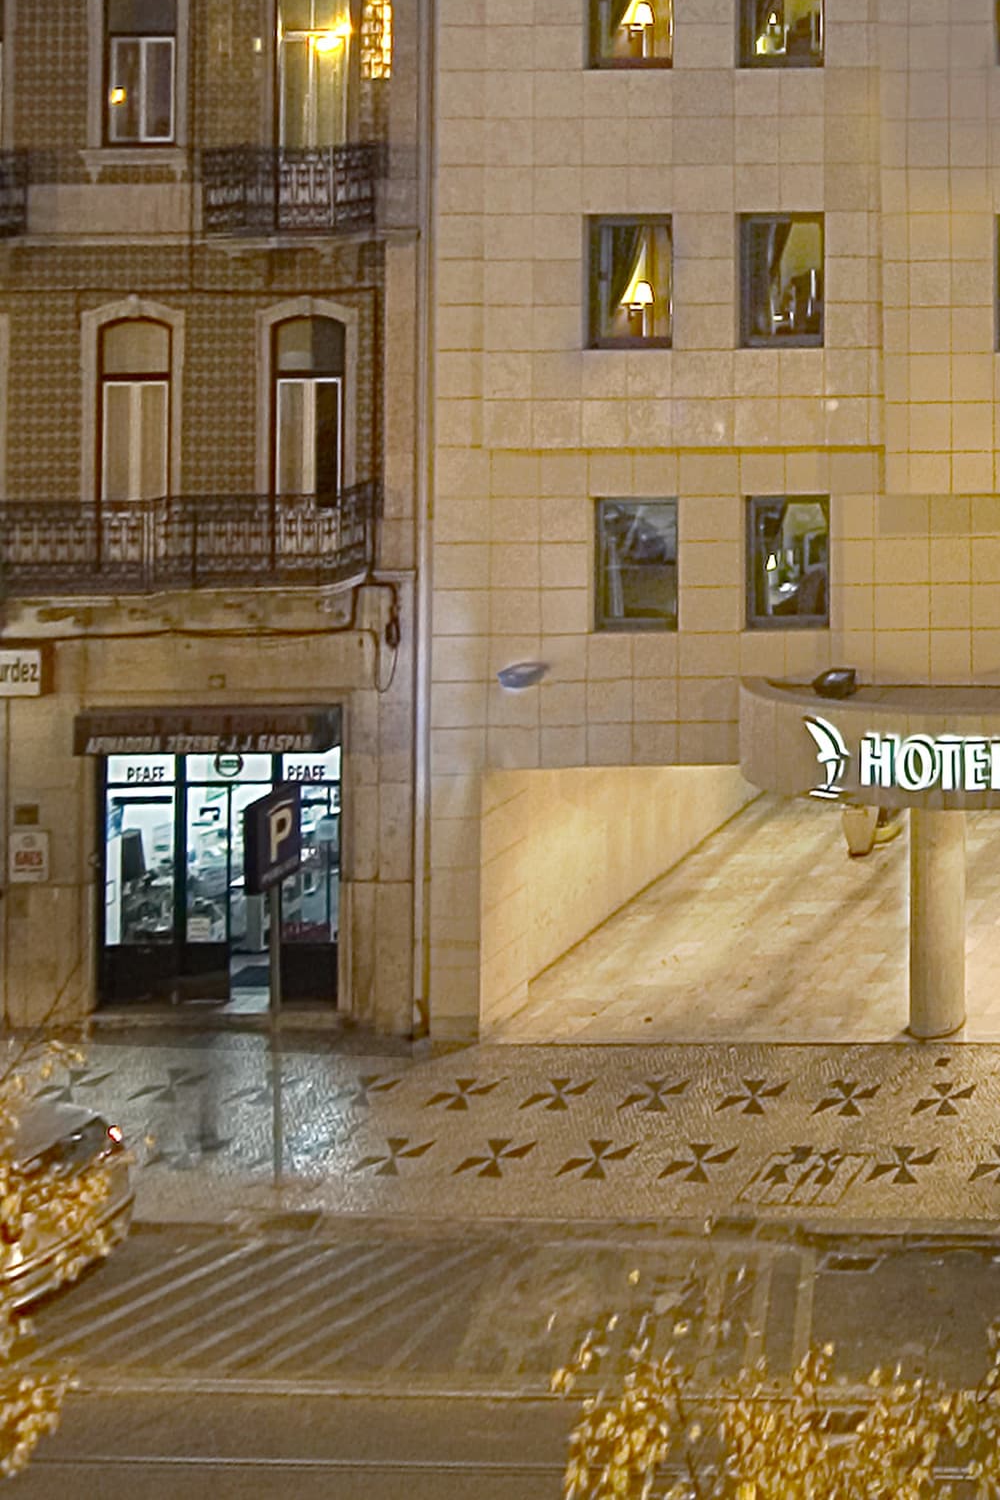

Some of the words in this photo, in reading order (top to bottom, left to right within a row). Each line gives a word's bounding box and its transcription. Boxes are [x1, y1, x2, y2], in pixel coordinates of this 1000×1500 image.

[127, 766, 165, 781] PFAFF
[287, 765, 326, 781] PFAFF
[270, 807, 293, 863] P
